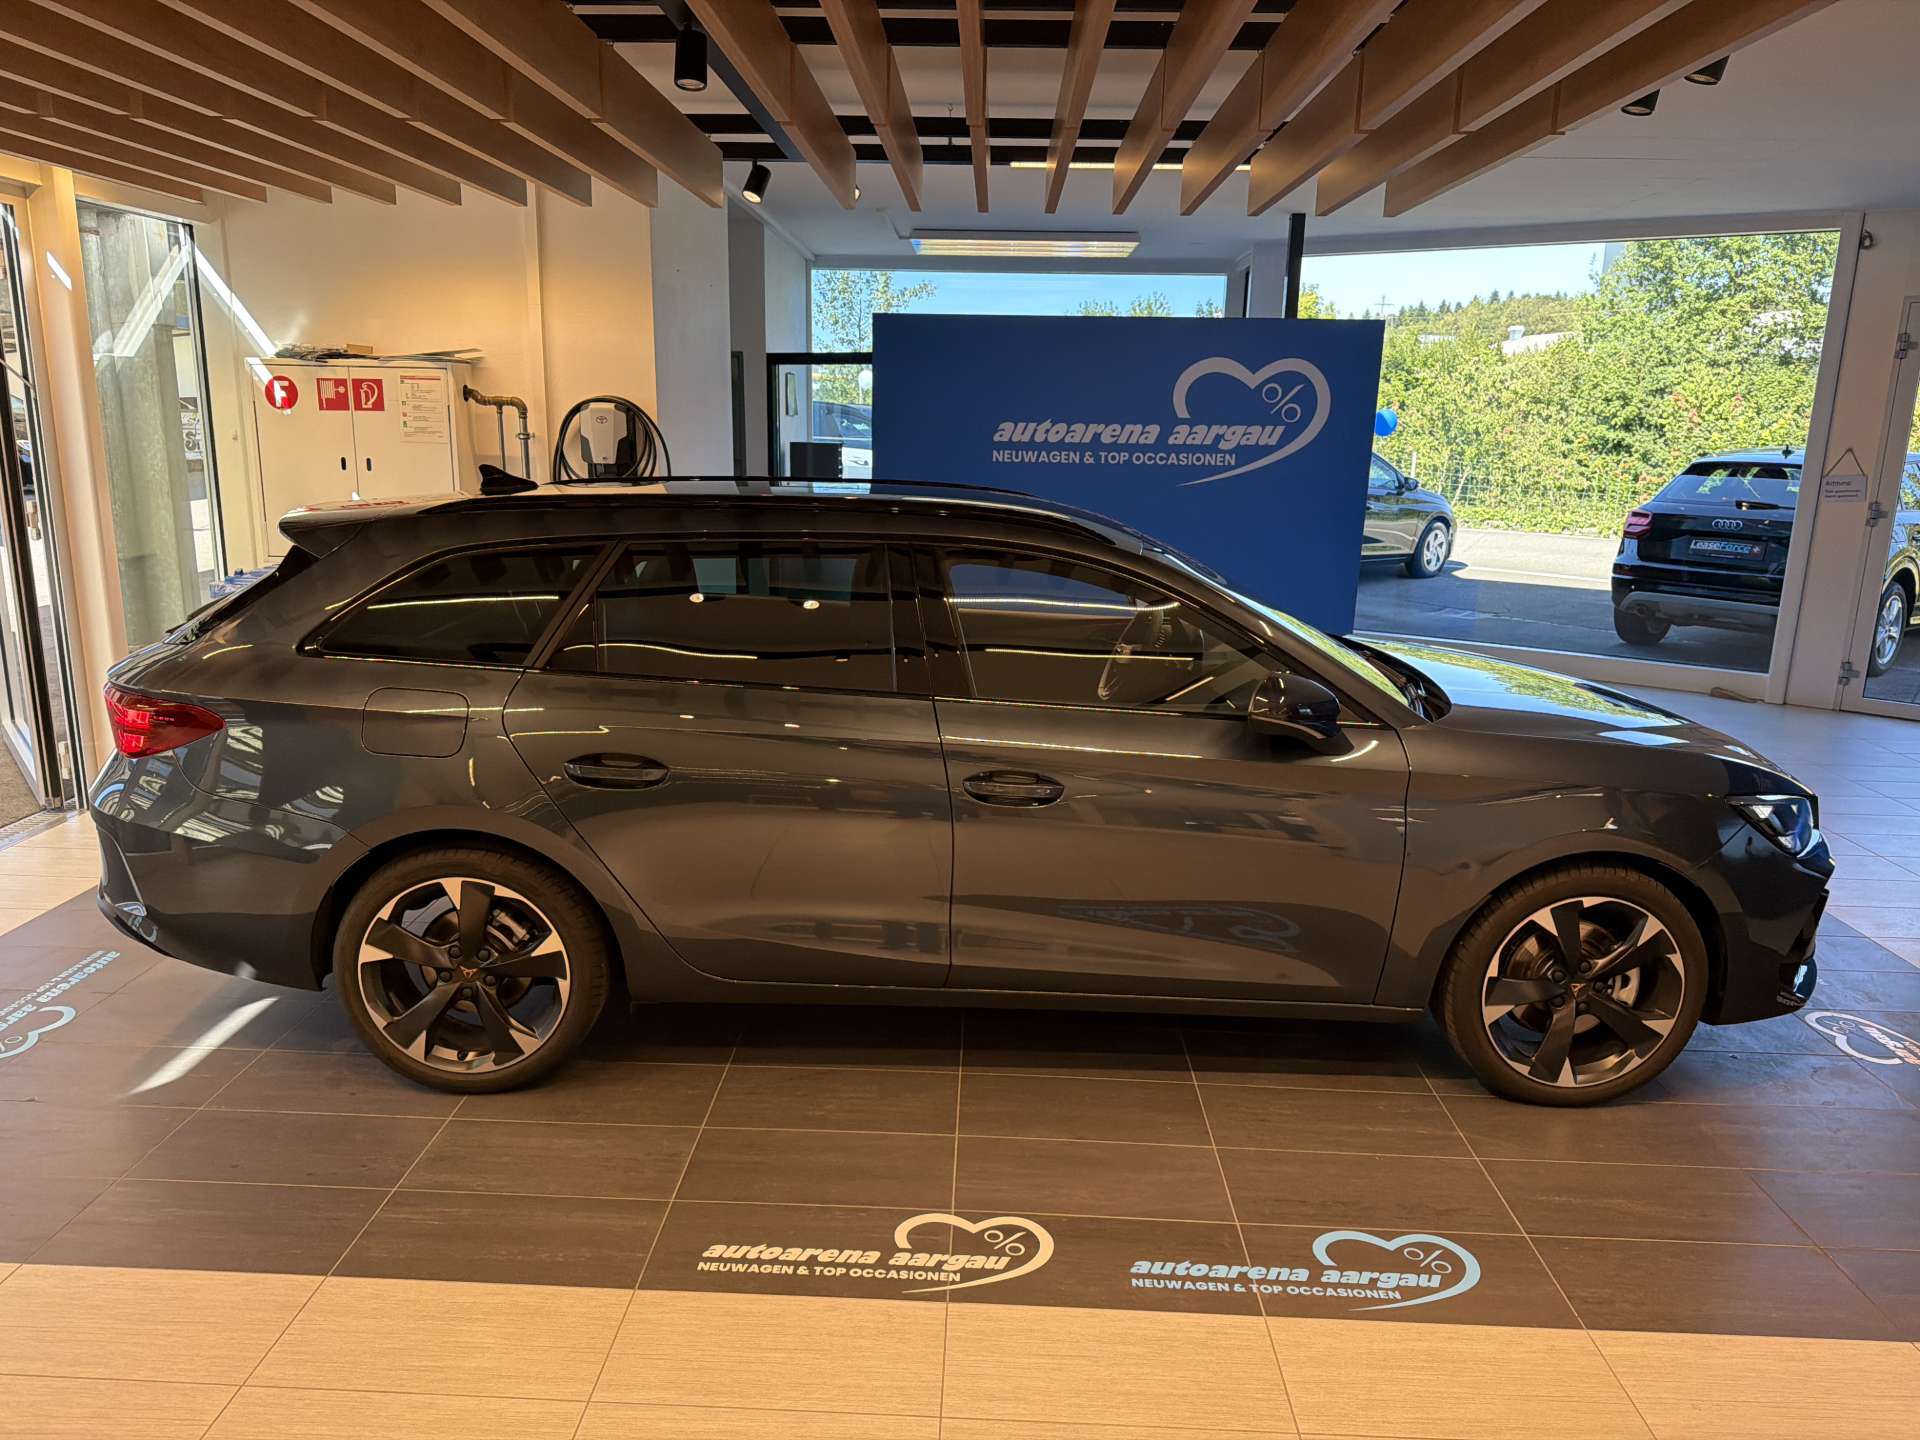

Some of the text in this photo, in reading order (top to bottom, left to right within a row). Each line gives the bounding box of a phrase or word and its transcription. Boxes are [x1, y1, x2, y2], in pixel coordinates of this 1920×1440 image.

[993, 419, 1286, 451] autoarena aargau
[992, 450, 1236, 466] NEUWAGEN & TOP OCCASIONEN
[1690, 538, 1751, 554] LeaseForce
[702, 1243, 1012, 1271] autoarena aargau
[696, 1261, 961, 1282] NEUWAGEN & TOP OCCASIONEN
[1129, 1258, 1442, 1289] autoarena aargau
[1131, 1278, 1402, 1300] NEUWAGEN & TOP OCCASIONEN
